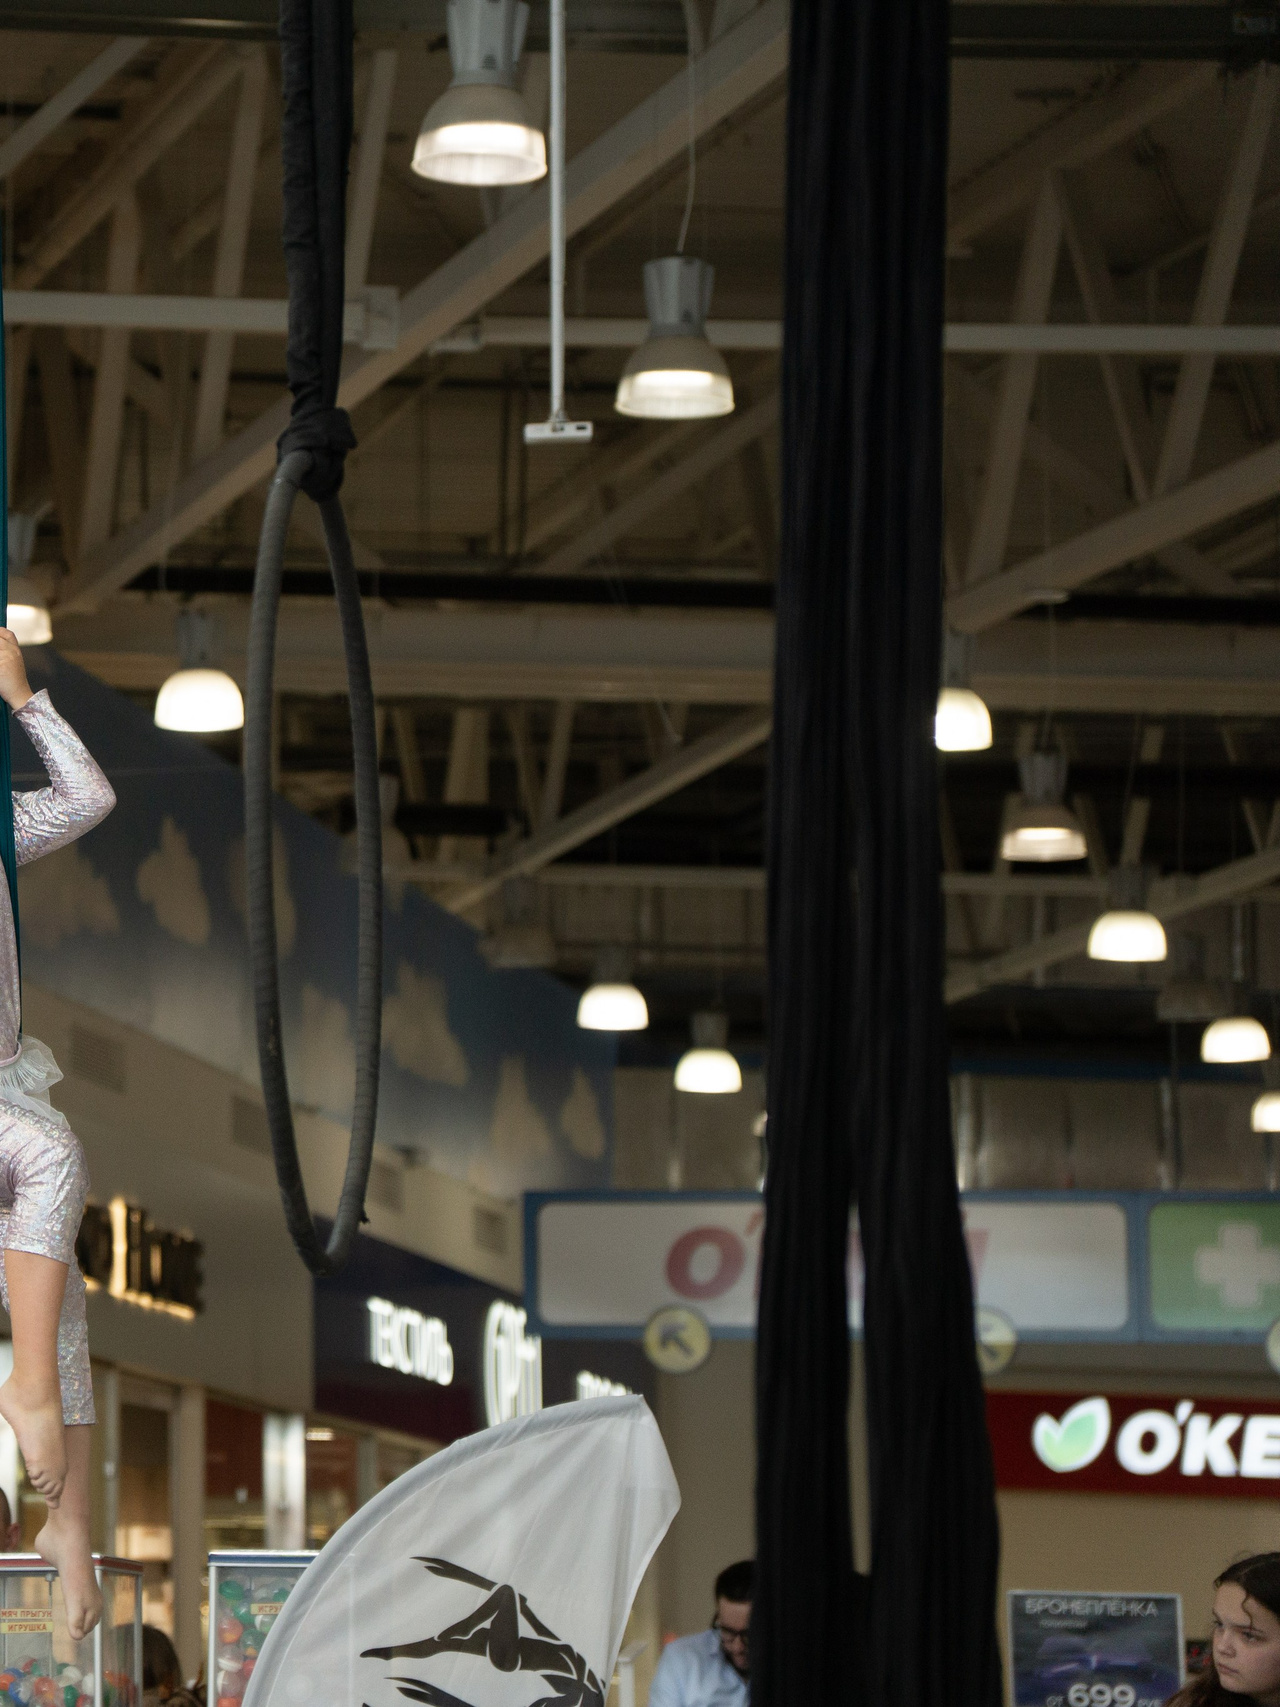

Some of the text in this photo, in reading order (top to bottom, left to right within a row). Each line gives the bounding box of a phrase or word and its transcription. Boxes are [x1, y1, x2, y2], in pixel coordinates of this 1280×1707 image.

[1, 1610, 52, 1618] МЯЧ ПРЫГУН
[7, 1623, 47, 1632] ИГРУШКА
[1068, 1683, 1136, 1707] 699
